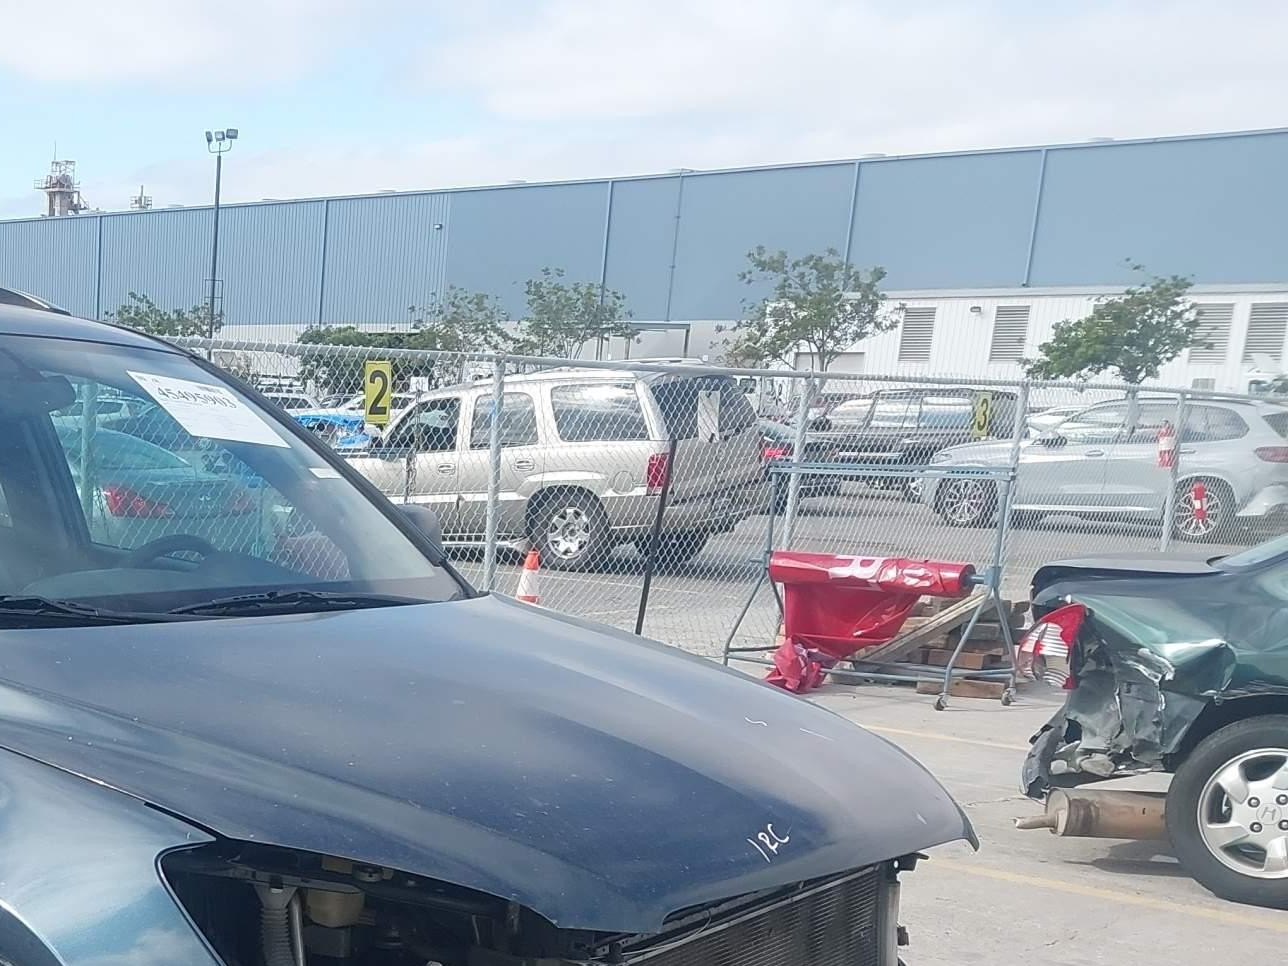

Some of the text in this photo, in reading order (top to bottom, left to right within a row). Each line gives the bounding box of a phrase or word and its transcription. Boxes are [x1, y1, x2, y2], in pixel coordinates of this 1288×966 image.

[157, 386, 238, 409] 45495903
[368, 369, 388, 415] 2
[977, 398, 989, 431] 3
